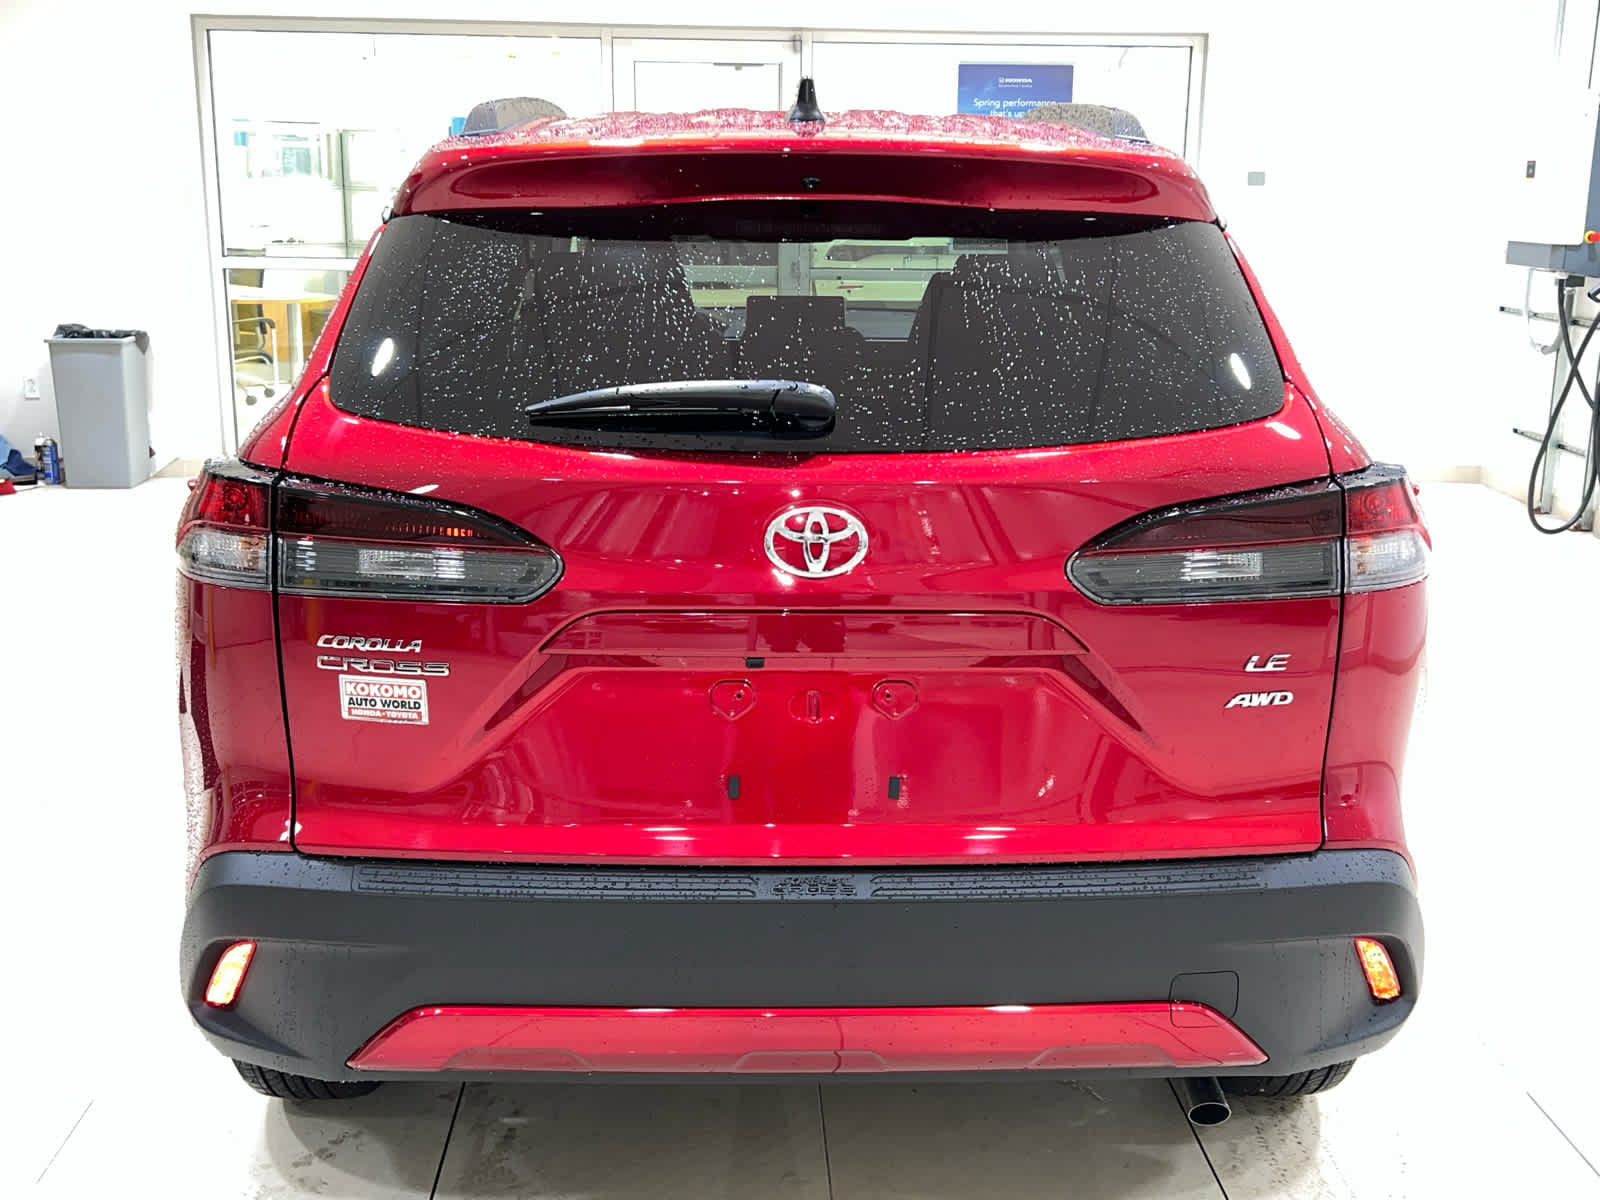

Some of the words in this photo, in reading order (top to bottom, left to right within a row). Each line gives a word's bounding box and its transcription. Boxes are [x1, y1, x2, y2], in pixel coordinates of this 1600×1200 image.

[973, 97, 1001, 109] Spring
[317, 634, 422, 653] COROLLA
[316, 655, 450, 677] CROSS
[1244, 653, 1292, 672] LE
[345, 681, 421, 699] KOKOMO
[348, 697, 377, 708] AUTO
[380, 699, 421, 710] WORLD
[1224, 690, 1294, 709] AWD
[351, 708, 382, 717] HONDA
[386, 710, 419, 720] TOYOTA
